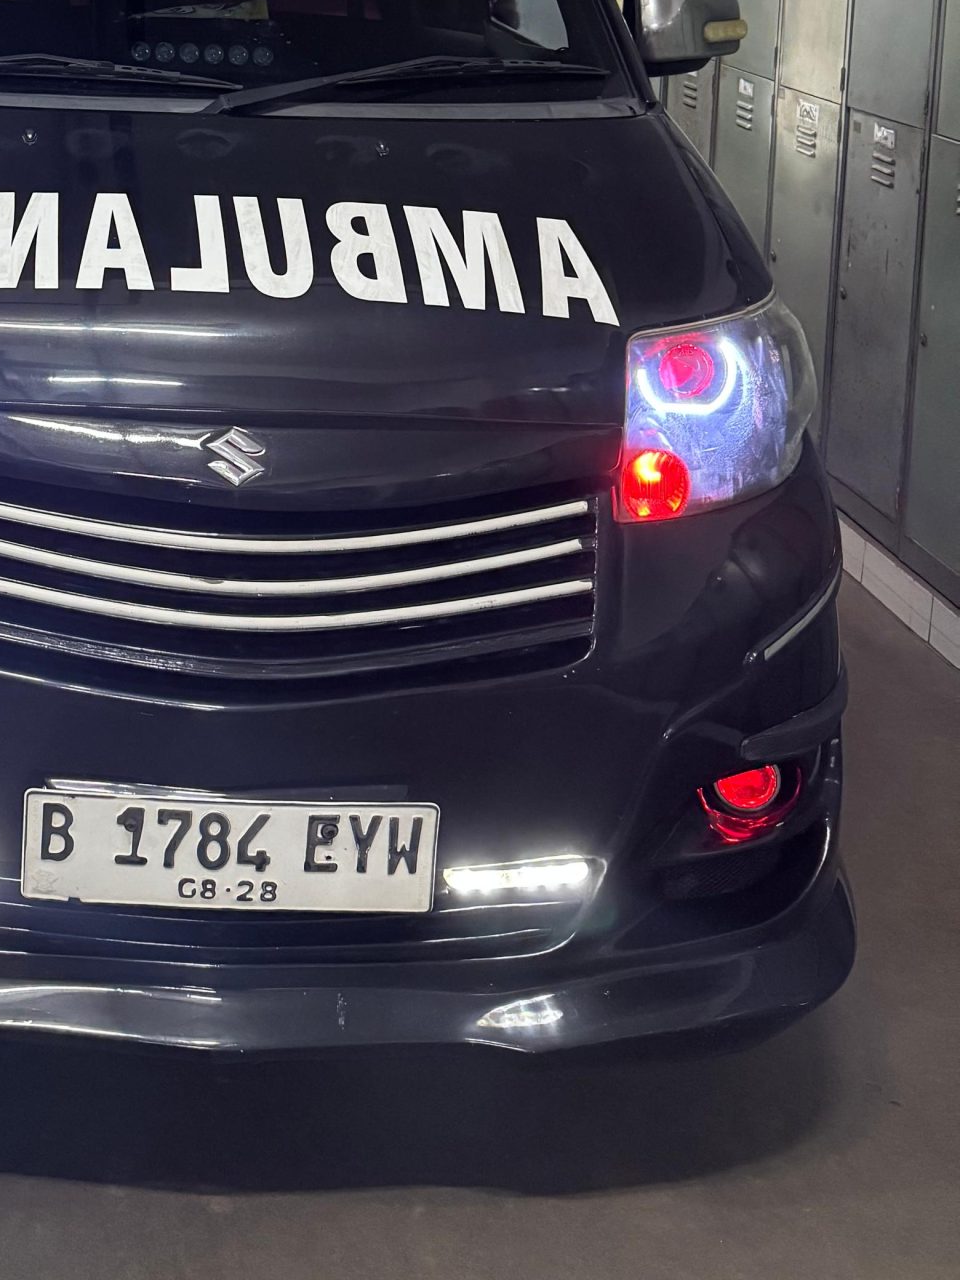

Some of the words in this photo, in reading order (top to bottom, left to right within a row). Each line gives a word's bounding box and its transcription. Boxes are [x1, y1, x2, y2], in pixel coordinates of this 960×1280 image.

[40, 802, 75, 861] B
[114, 807, 271, 872] 1784
[304, 814, 424, 875] EYW
